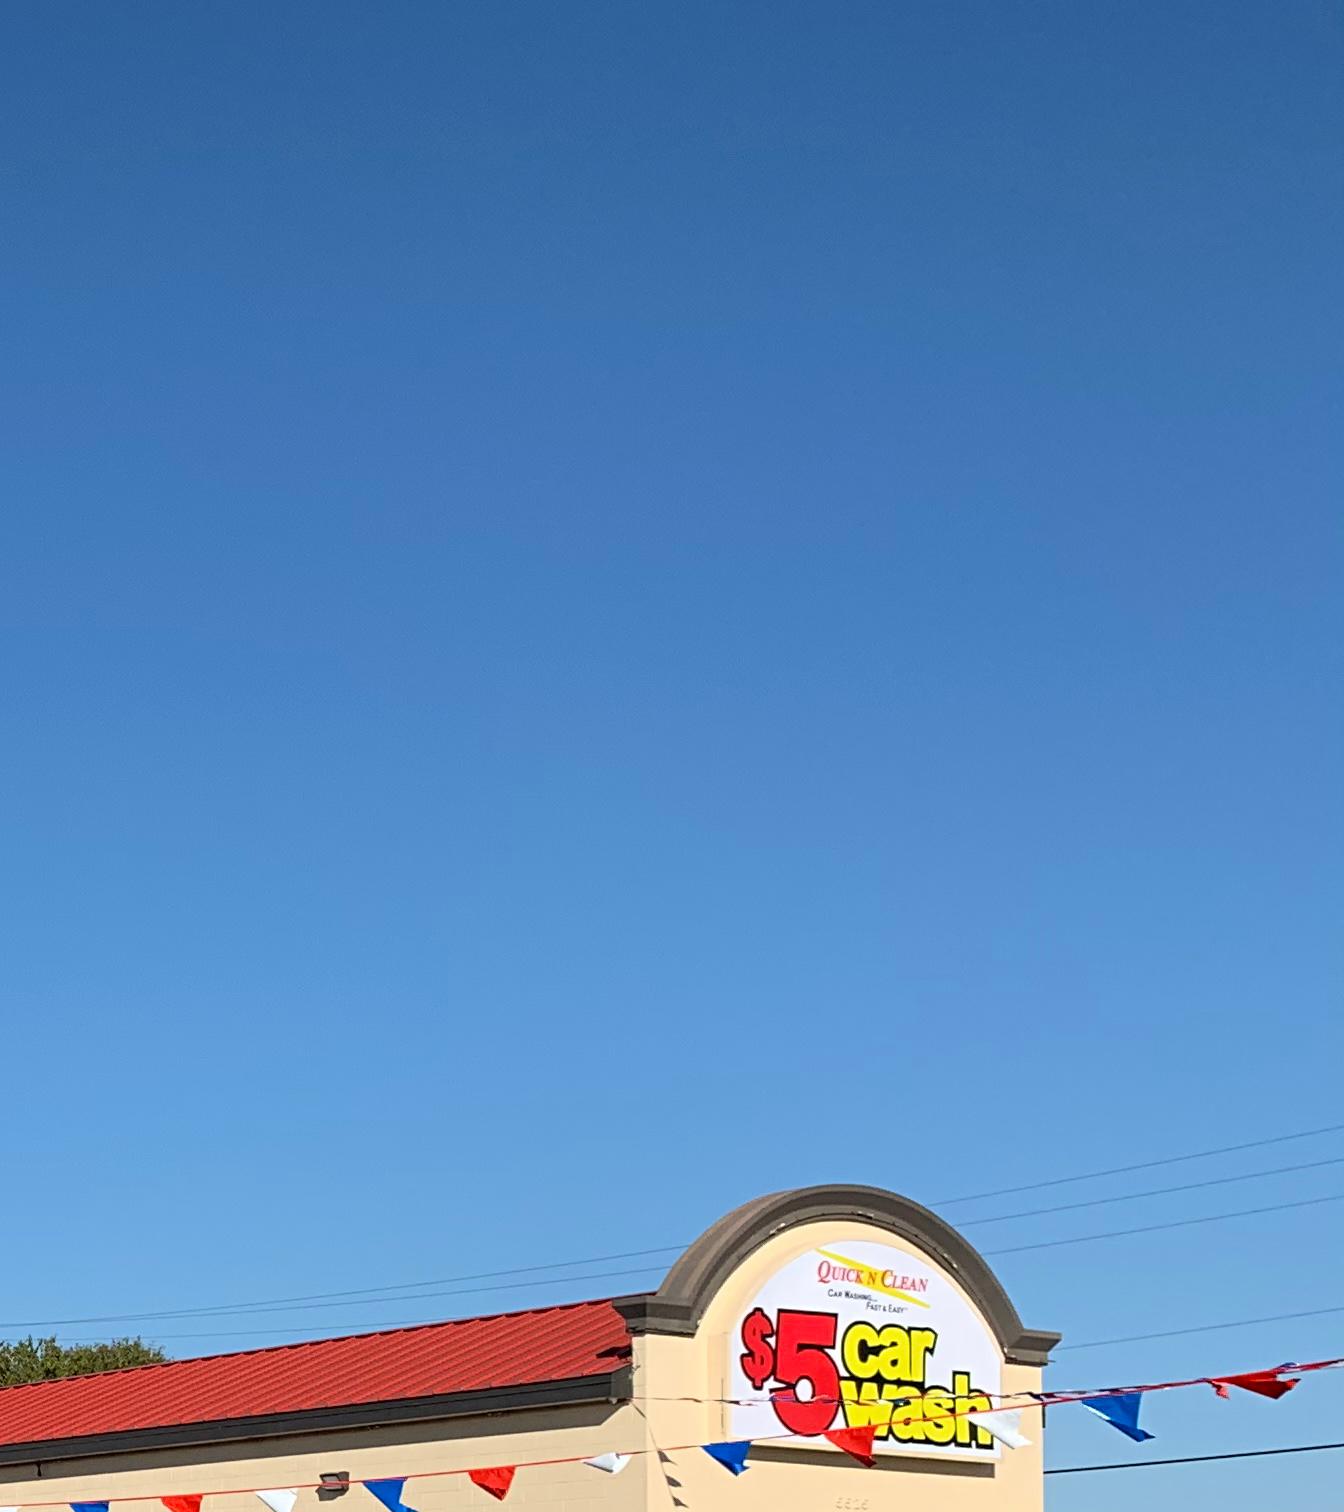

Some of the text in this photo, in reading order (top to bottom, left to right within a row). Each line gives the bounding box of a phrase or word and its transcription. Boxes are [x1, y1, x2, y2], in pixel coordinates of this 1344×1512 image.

[817, 1260, 929, 1292] QUICK N CLEAN
[827, 1288, 843, 1298] CAR
[865, 1302, 882, 1311] FAST
[740, 1307, 938, 1437] $5 car
[839, 1370, 994, 1449] wash
